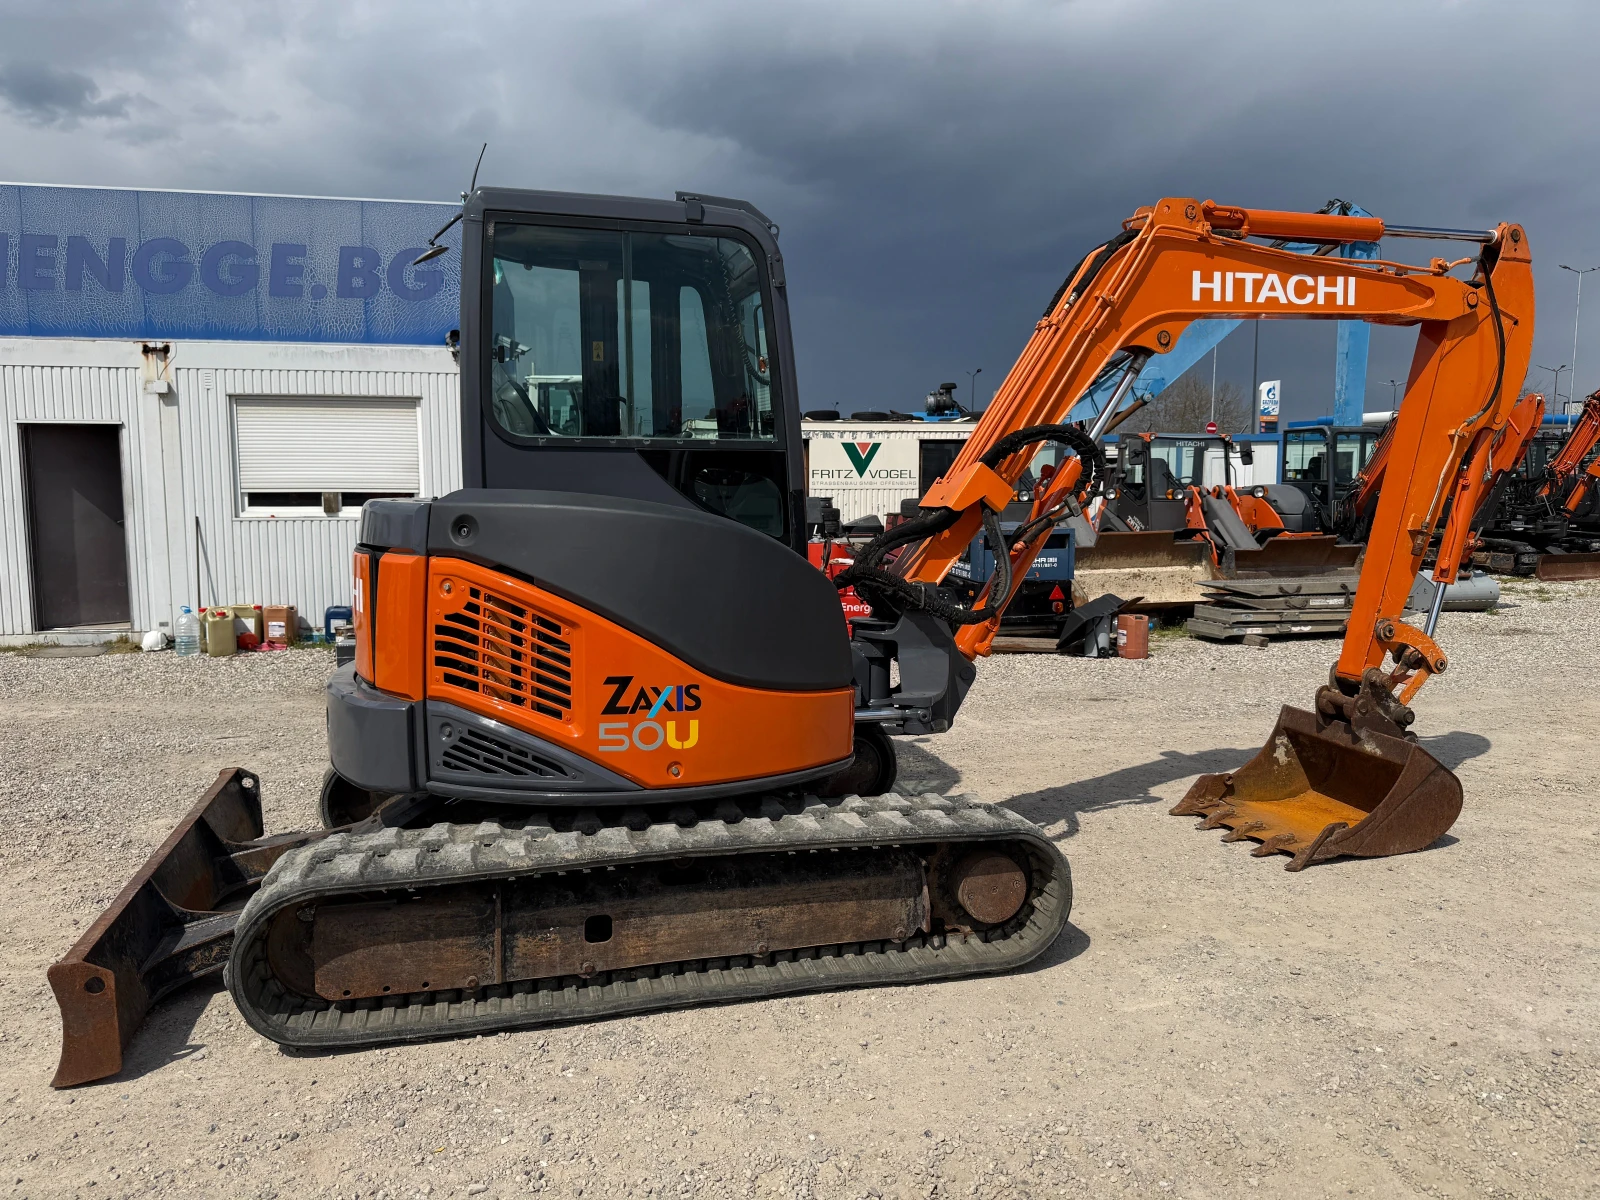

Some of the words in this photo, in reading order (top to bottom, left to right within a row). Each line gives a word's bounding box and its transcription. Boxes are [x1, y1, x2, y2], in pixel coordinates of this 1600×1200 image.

[0, 232, 445, 300] ENGGE.BG
[1192, 270, 1356, 306] HITACHI
[811, 469, 854, 479] FRITZ
[868, 469, 917, 479] VOGEL
[842, 602, 873, 614] Energ
[600, 676, 702, 718] ZAXIS
[598, 719, 699, 751] 50U
